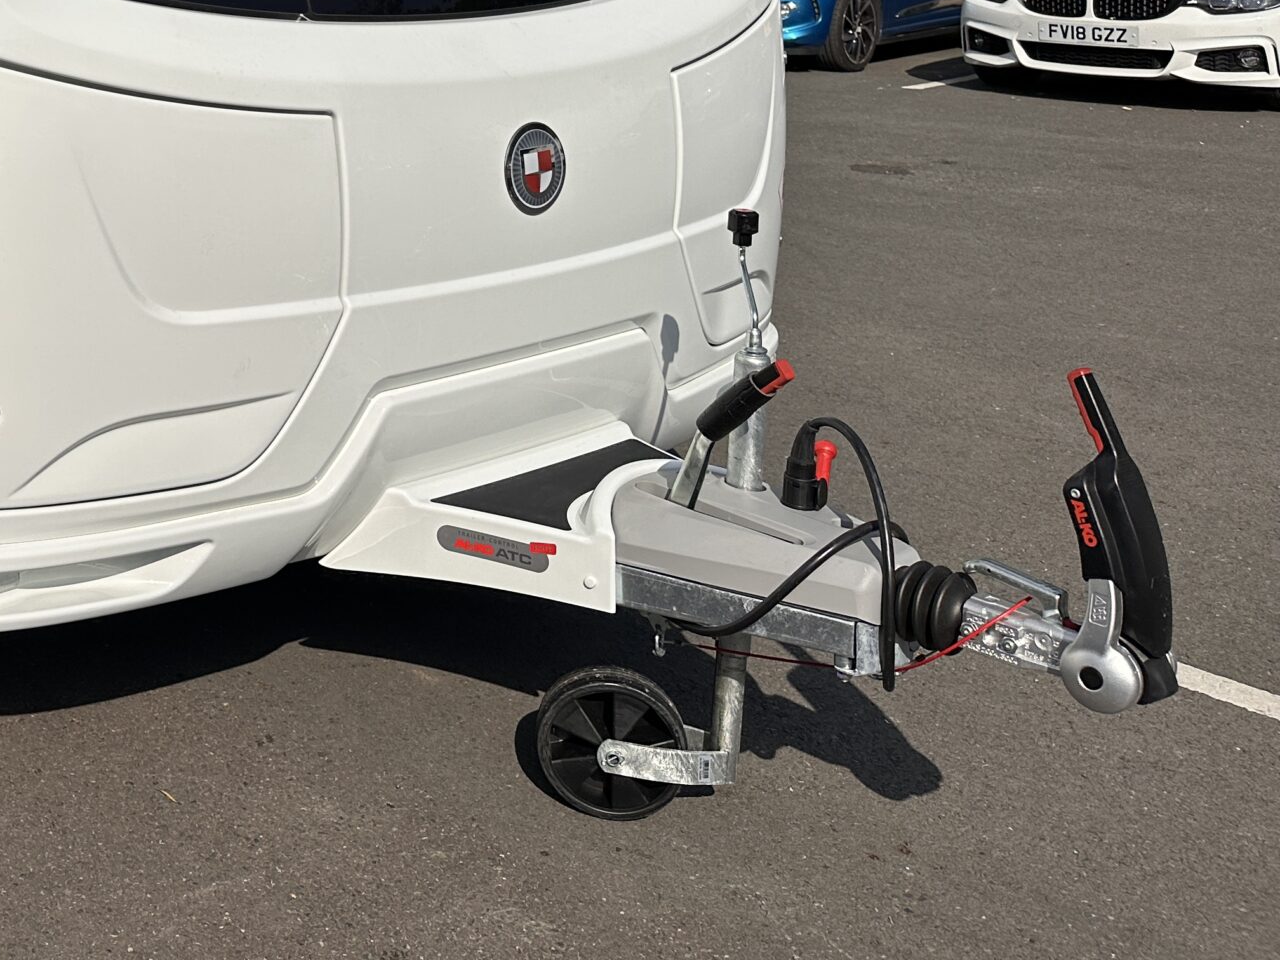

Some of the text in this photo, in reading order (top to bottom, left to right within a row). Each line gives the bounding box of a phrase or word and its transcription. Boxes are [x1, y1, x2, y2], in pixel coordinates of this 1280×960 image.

[1048, 23, 1128, 43] FV18 GZZ
[1071, 499, 1098, 548] AL-KO
[496, 548, 532, 565] ATC
